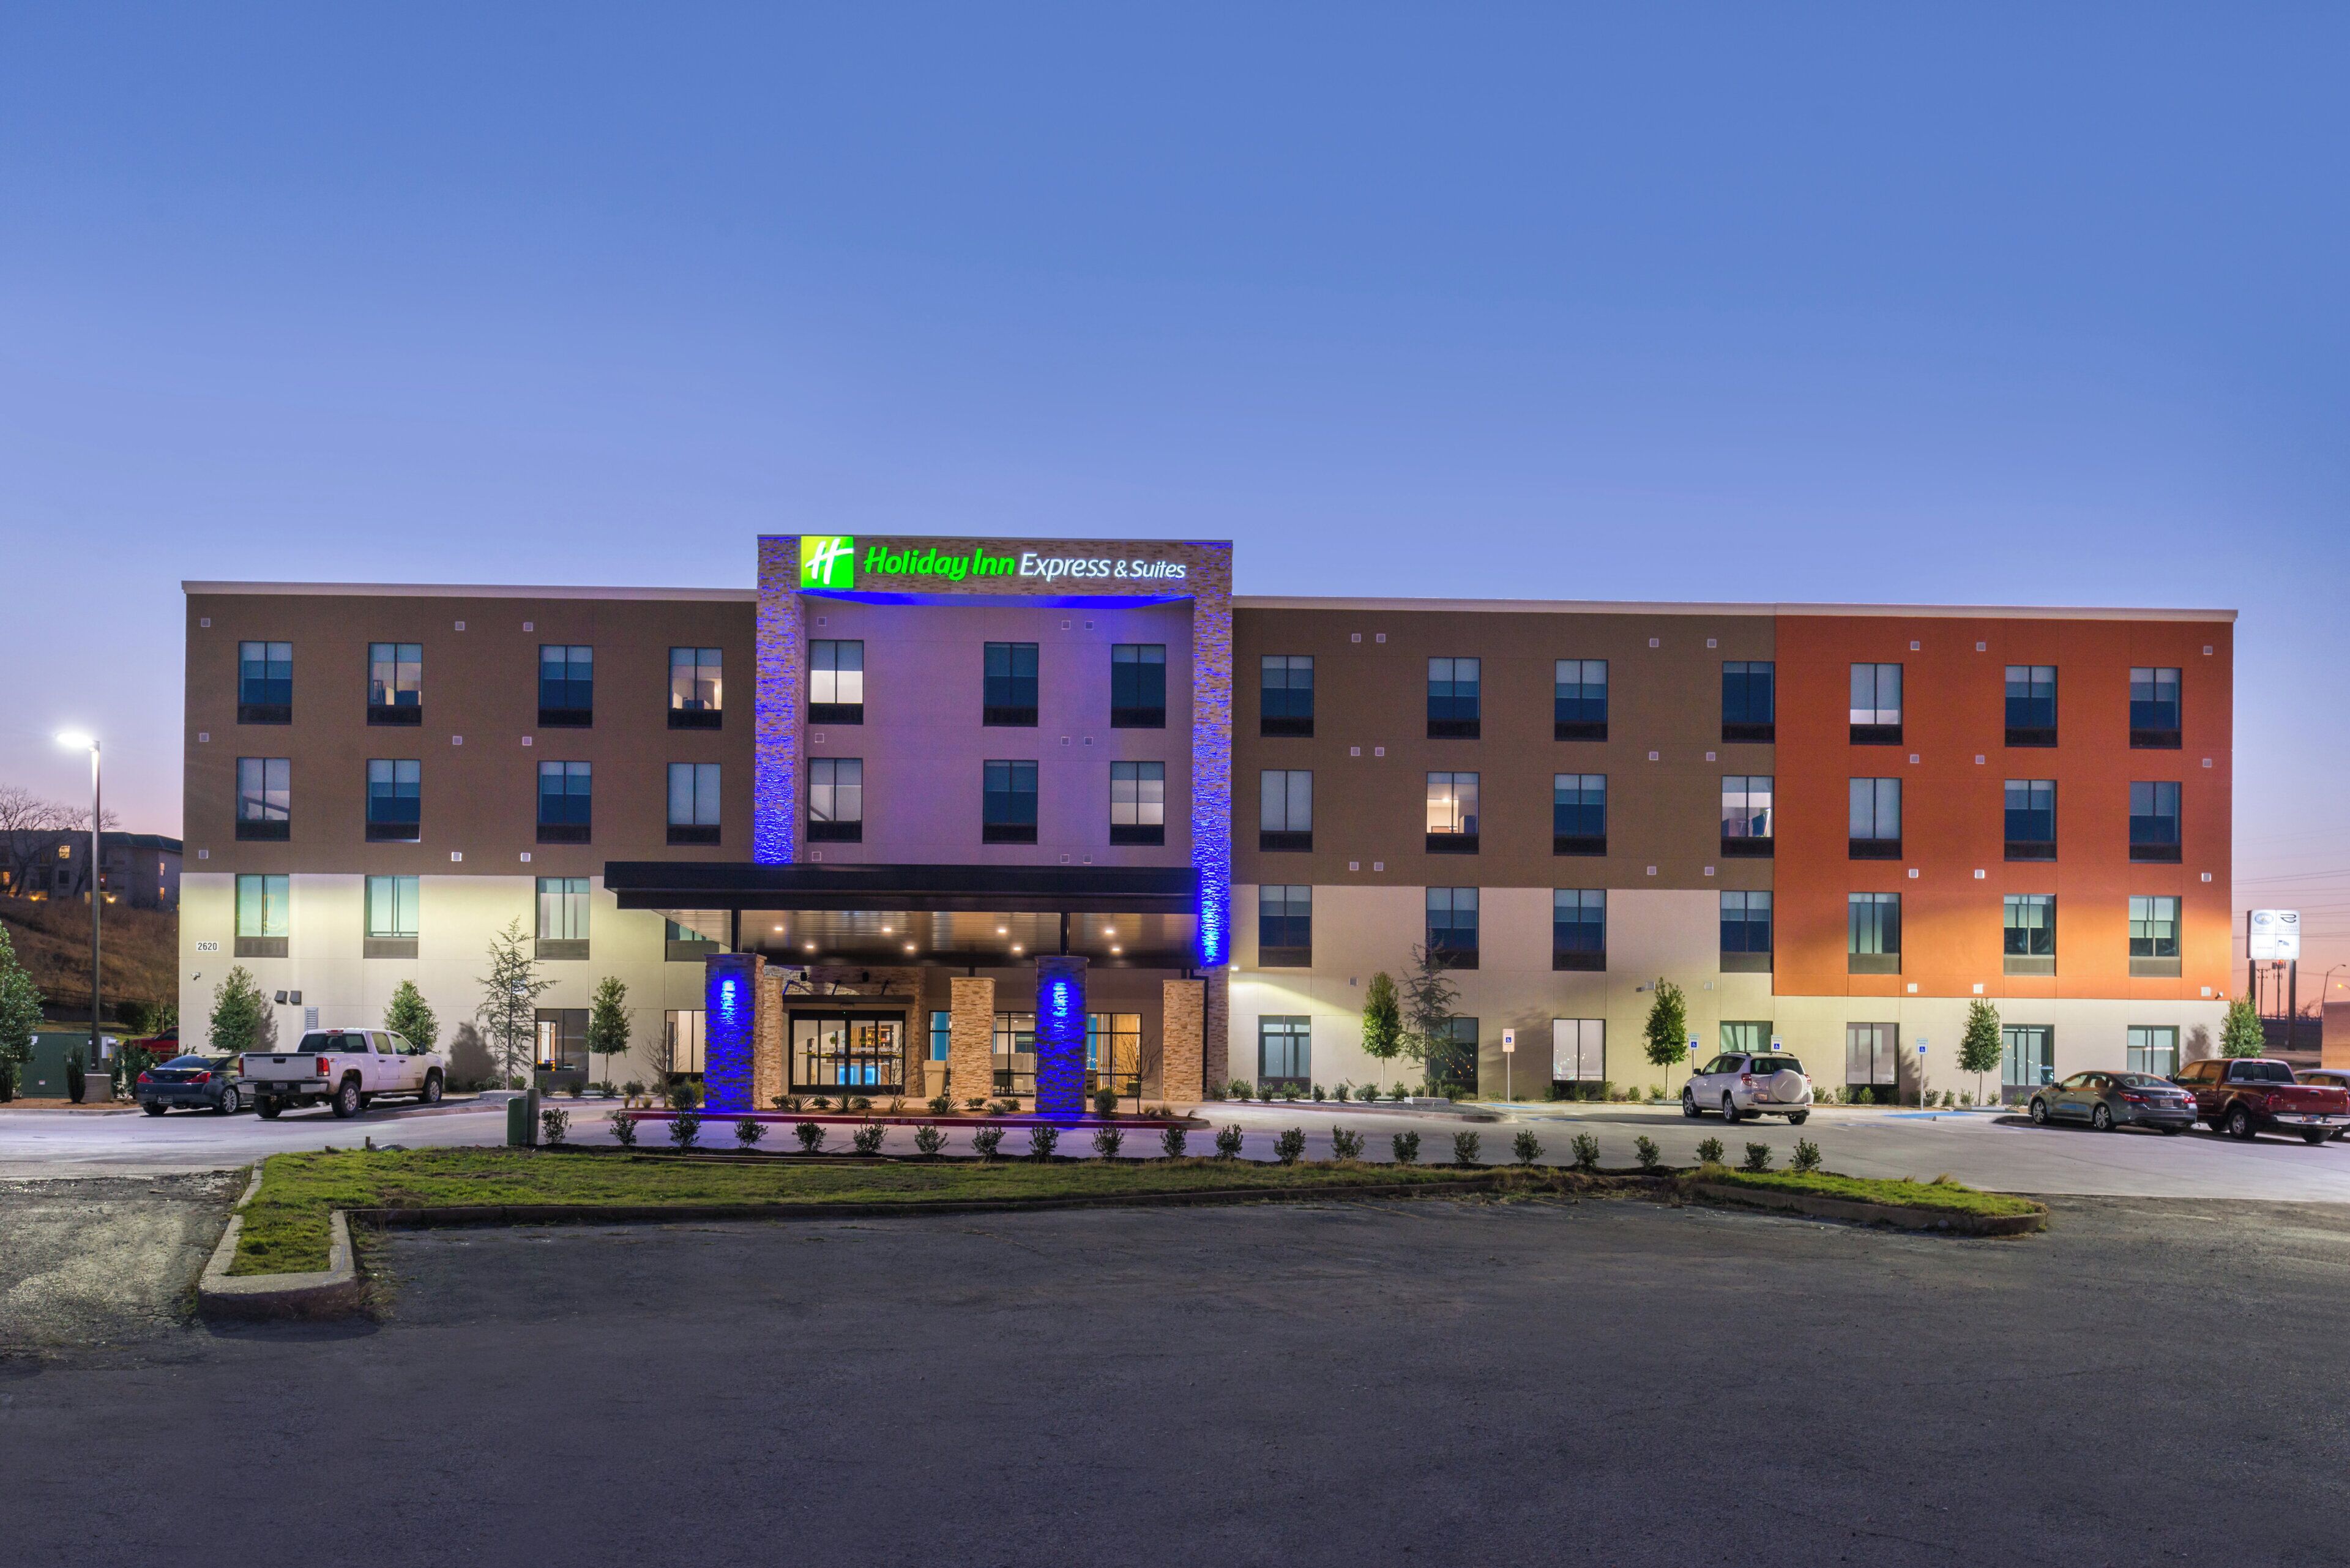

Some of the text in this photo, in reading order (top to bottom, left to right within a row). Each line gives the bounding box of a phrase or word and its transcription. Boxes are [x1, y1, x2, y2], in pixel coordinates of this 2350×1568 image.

[863, 547, 1187, 582] Holiday Inn Express & Suites
[198, 942, 217, 950] 2620
